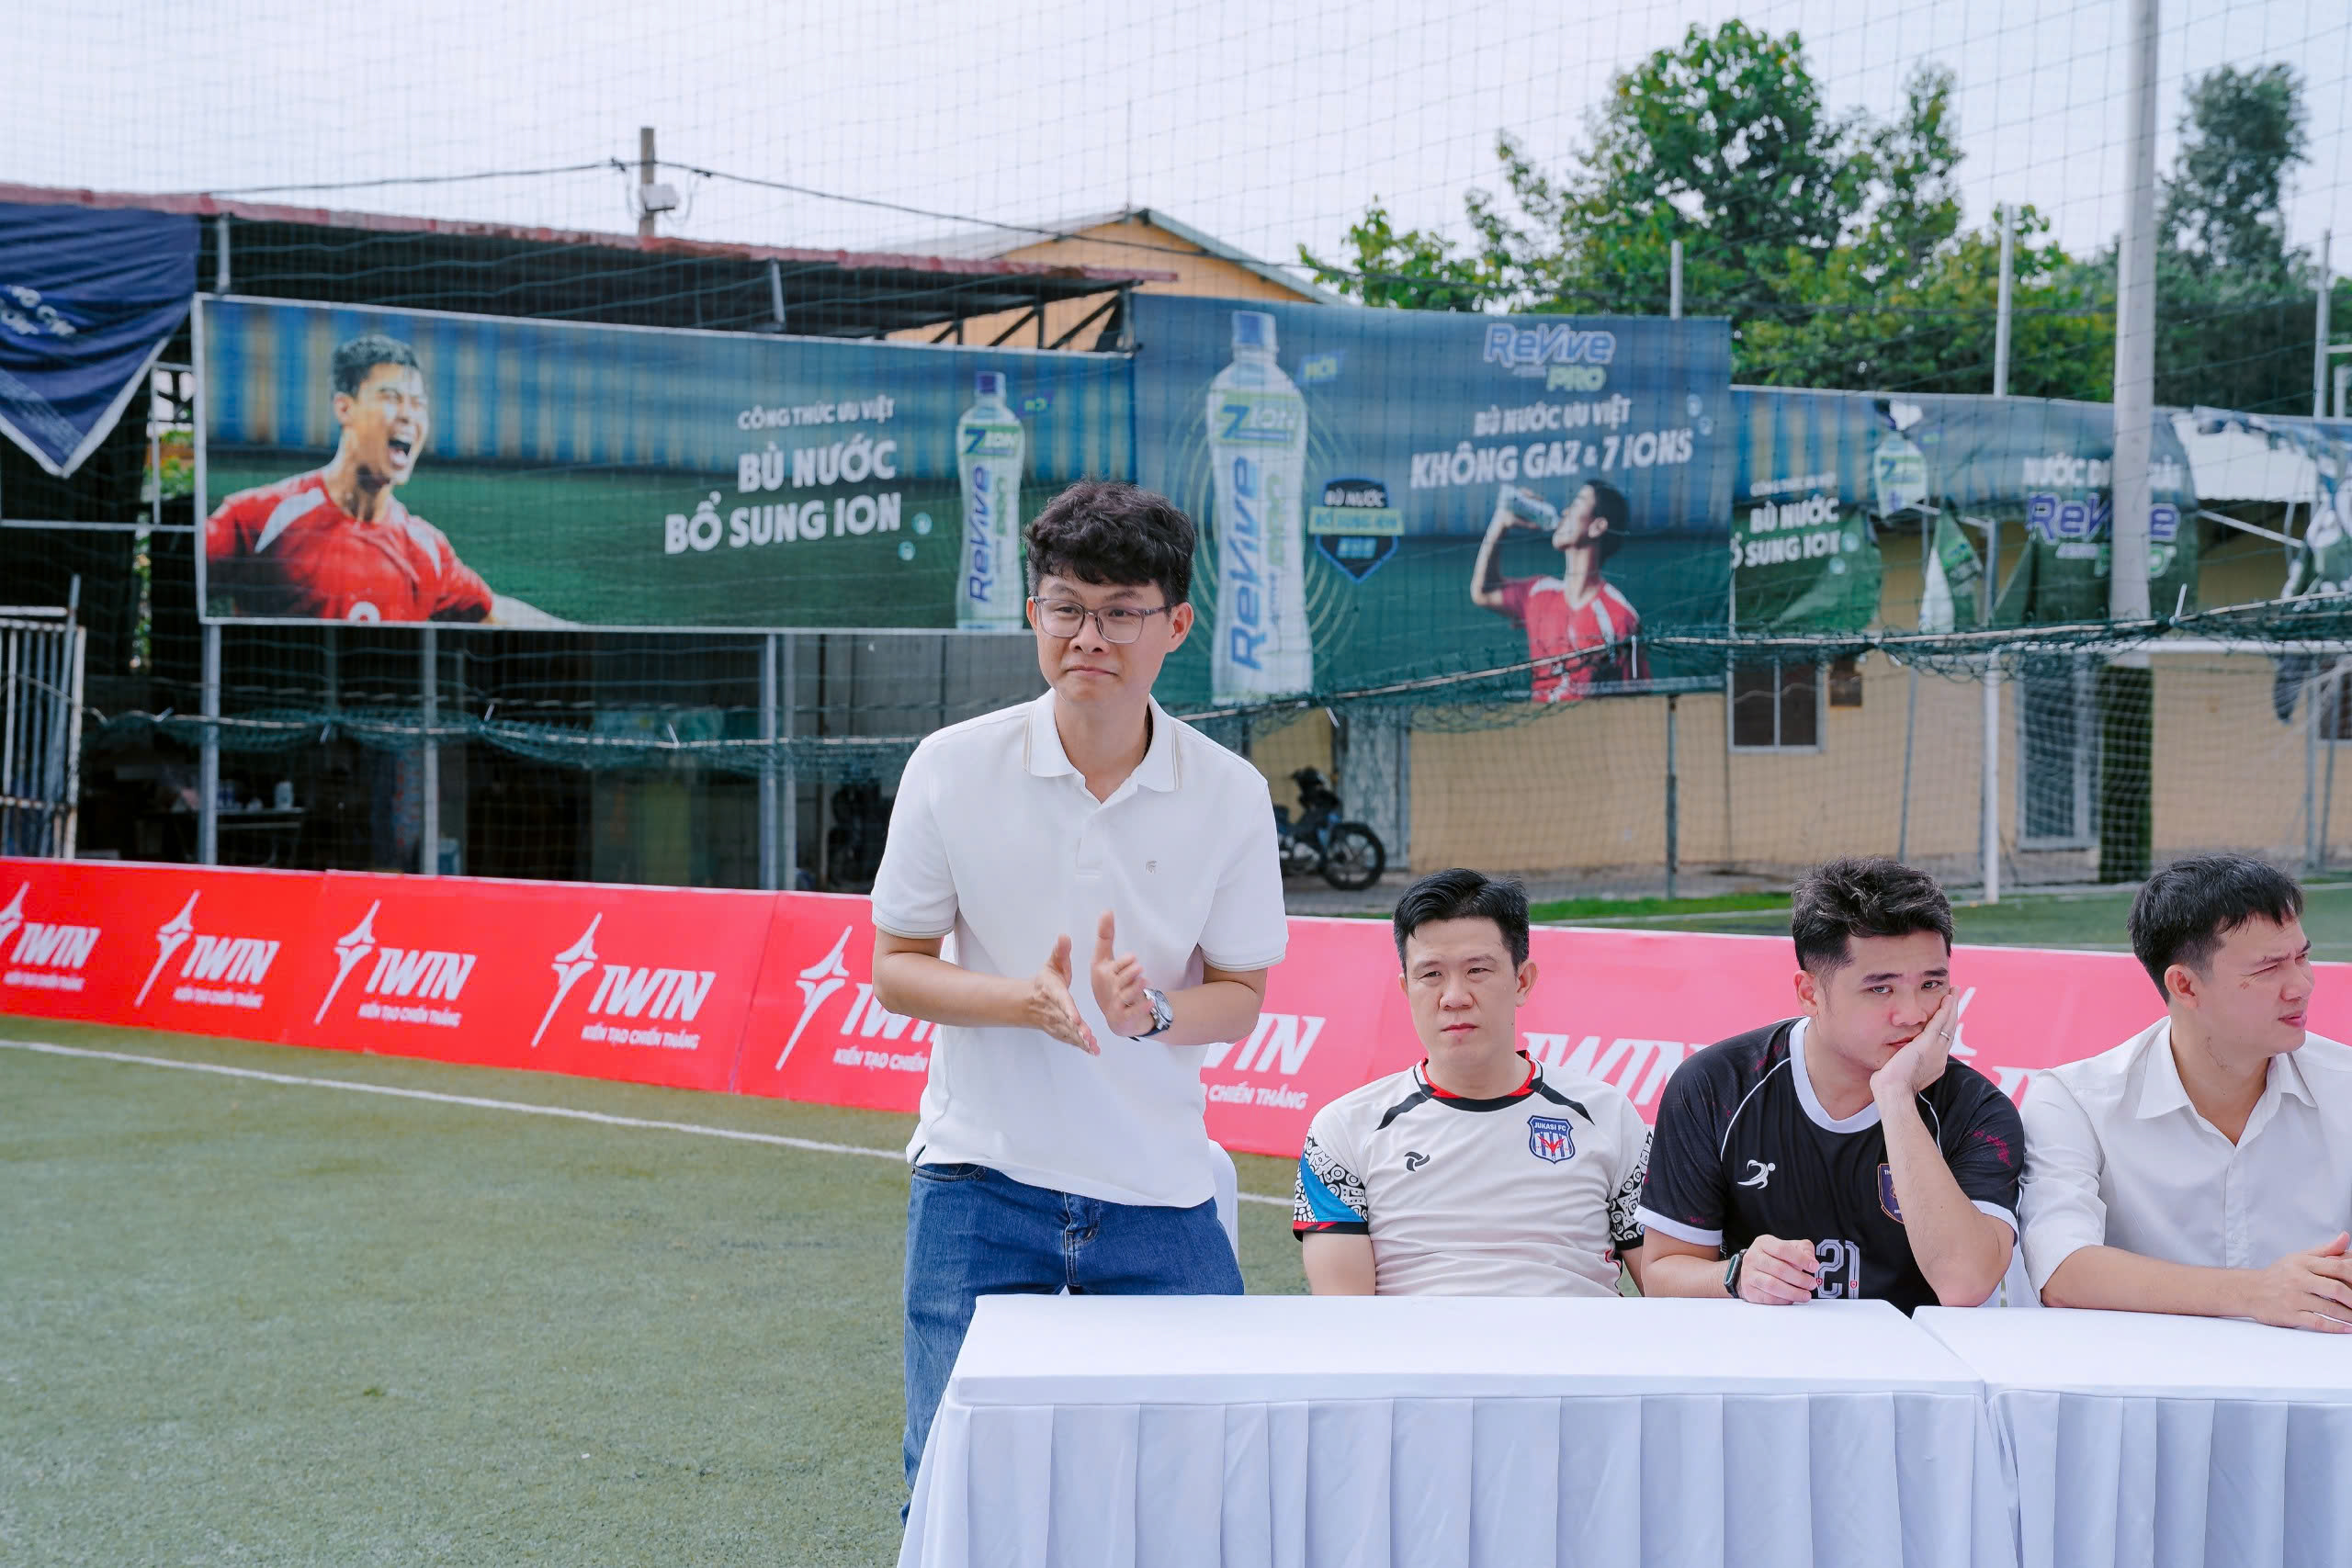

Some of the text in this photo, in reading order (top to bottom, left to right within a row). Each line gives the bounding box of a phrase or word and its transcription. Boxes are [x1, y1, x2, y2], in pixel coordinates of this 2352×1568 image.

[1483, 323, 1617, 367] ReVive
[1546, 365, 1607, 392] PRO
[738, 404, 791, 430] CÔNG
[1473, 404, 1501, 437] BÙ
[1502, 400, 1562, 434] NƯỚC
[1592, 393, 1632, 431] VIỆT
[738, 433, 898, 492] BÙ NƯỚC
[1410, 440, 1520, 490] KHÔNG
[1522, 439, 1582, 479] GAZ
[1601, 435, 1621, 471] 7
[1622, 427, 1694, 468] IONS
[664, 491, 902, 555] BỔ SUNG ION
[969, 466, 994, 603] ReVive
[1749, 493, 1839, 534] BÙ NƯỚC
[1745, 536, 1803, 568] SUNG
[833, 1045, 930, 1073] KIẾN TẠO CHIẾN
[1208, 1081, 1255, 1105] CHIẾN
[1256, 1083, 1309, 1111] THẮNG
[1534, 1122, 1557, 1130] JUKASI
[1815, 1238, 1860, 1300] 21
